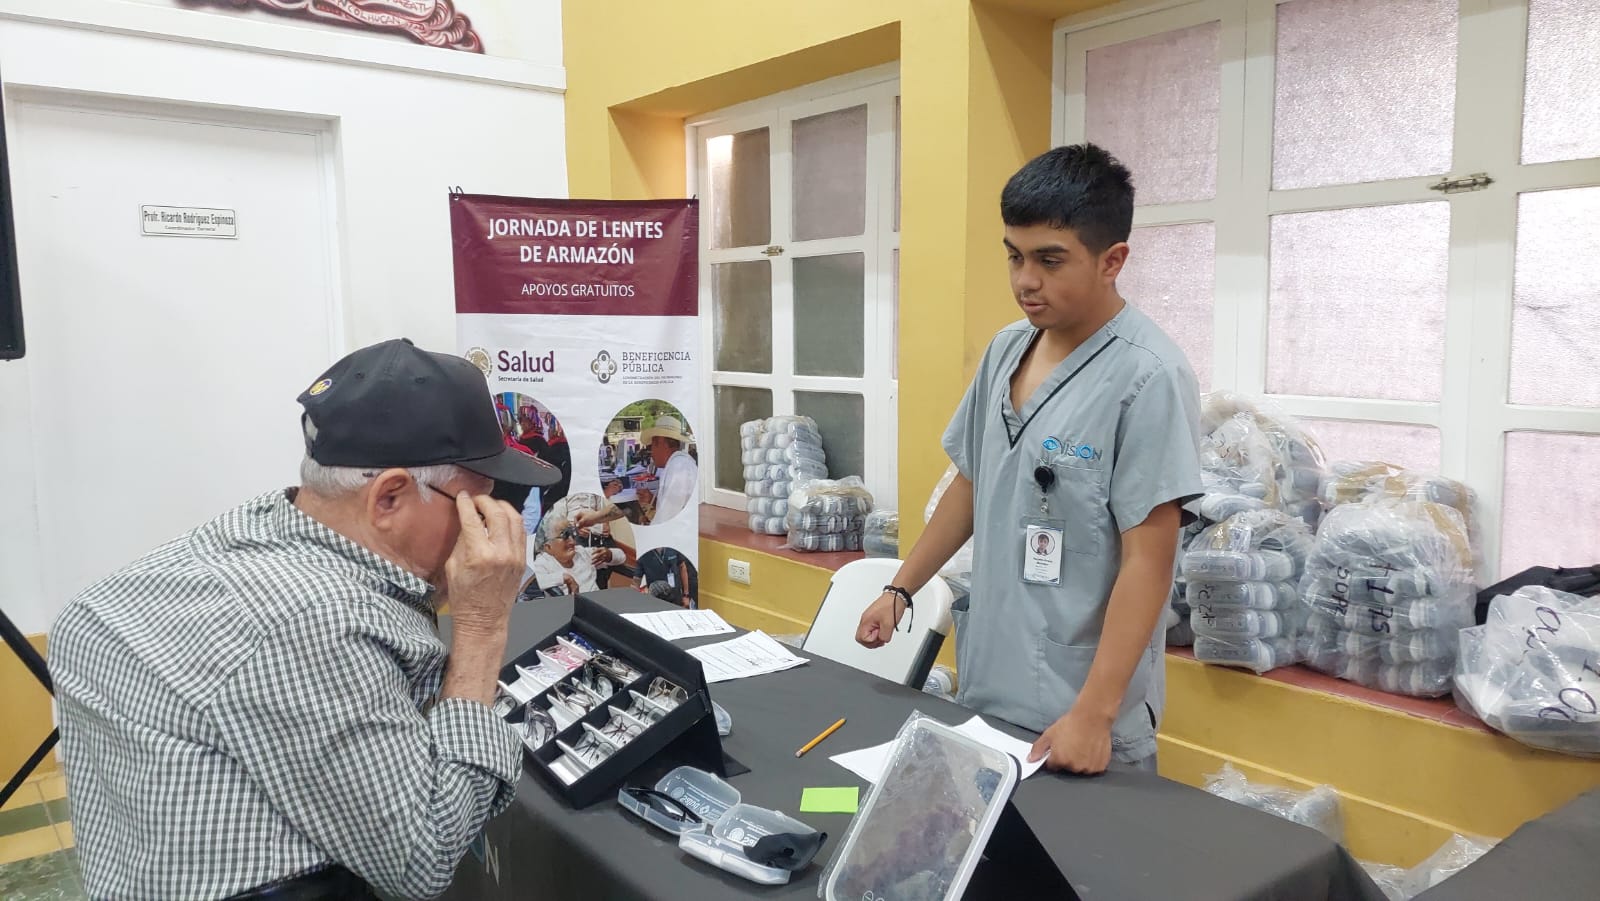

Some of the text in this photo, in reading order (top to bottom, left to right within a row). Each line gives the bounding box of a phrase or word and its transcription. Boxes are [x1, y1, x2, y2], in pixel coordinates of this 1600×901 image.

[487, 218, 664, 239] JORNADA DE LENTES
[520, 243, 634, 264] DE ARMAZÓN
[521, 283, 635, 297] APOYOS GRATUITOS
[497, 350, 555, 373] Salud
[622, 351, 691, 362] BENEFICENCIA
[622, 361, 665, 373] PÚBLICA
